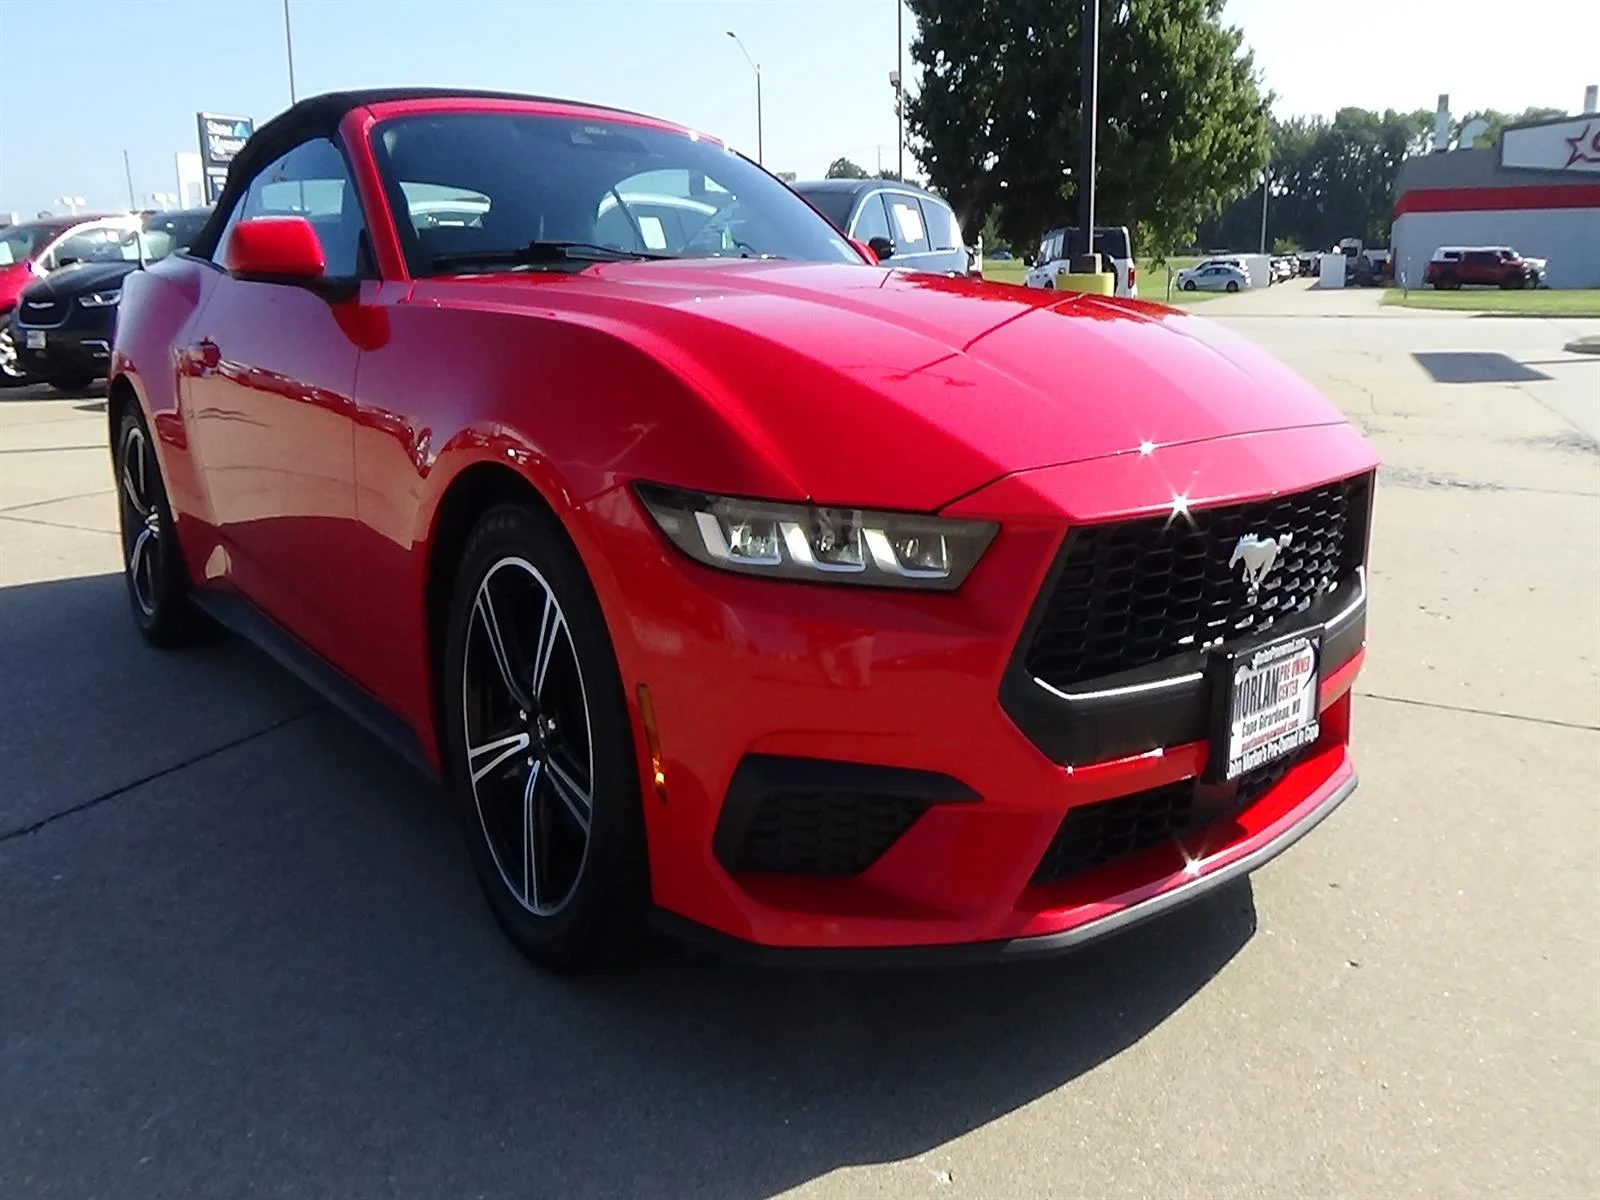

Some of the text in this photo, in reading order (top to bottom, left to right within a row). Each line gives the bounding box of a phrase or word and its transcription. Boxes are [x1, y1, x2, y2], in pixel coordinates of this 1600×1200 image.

[1234, 668, 1281, 722] MORLAN
[1279, 662, 1292, 682] PRE
[1242, 719, 1257, 738] Cape
